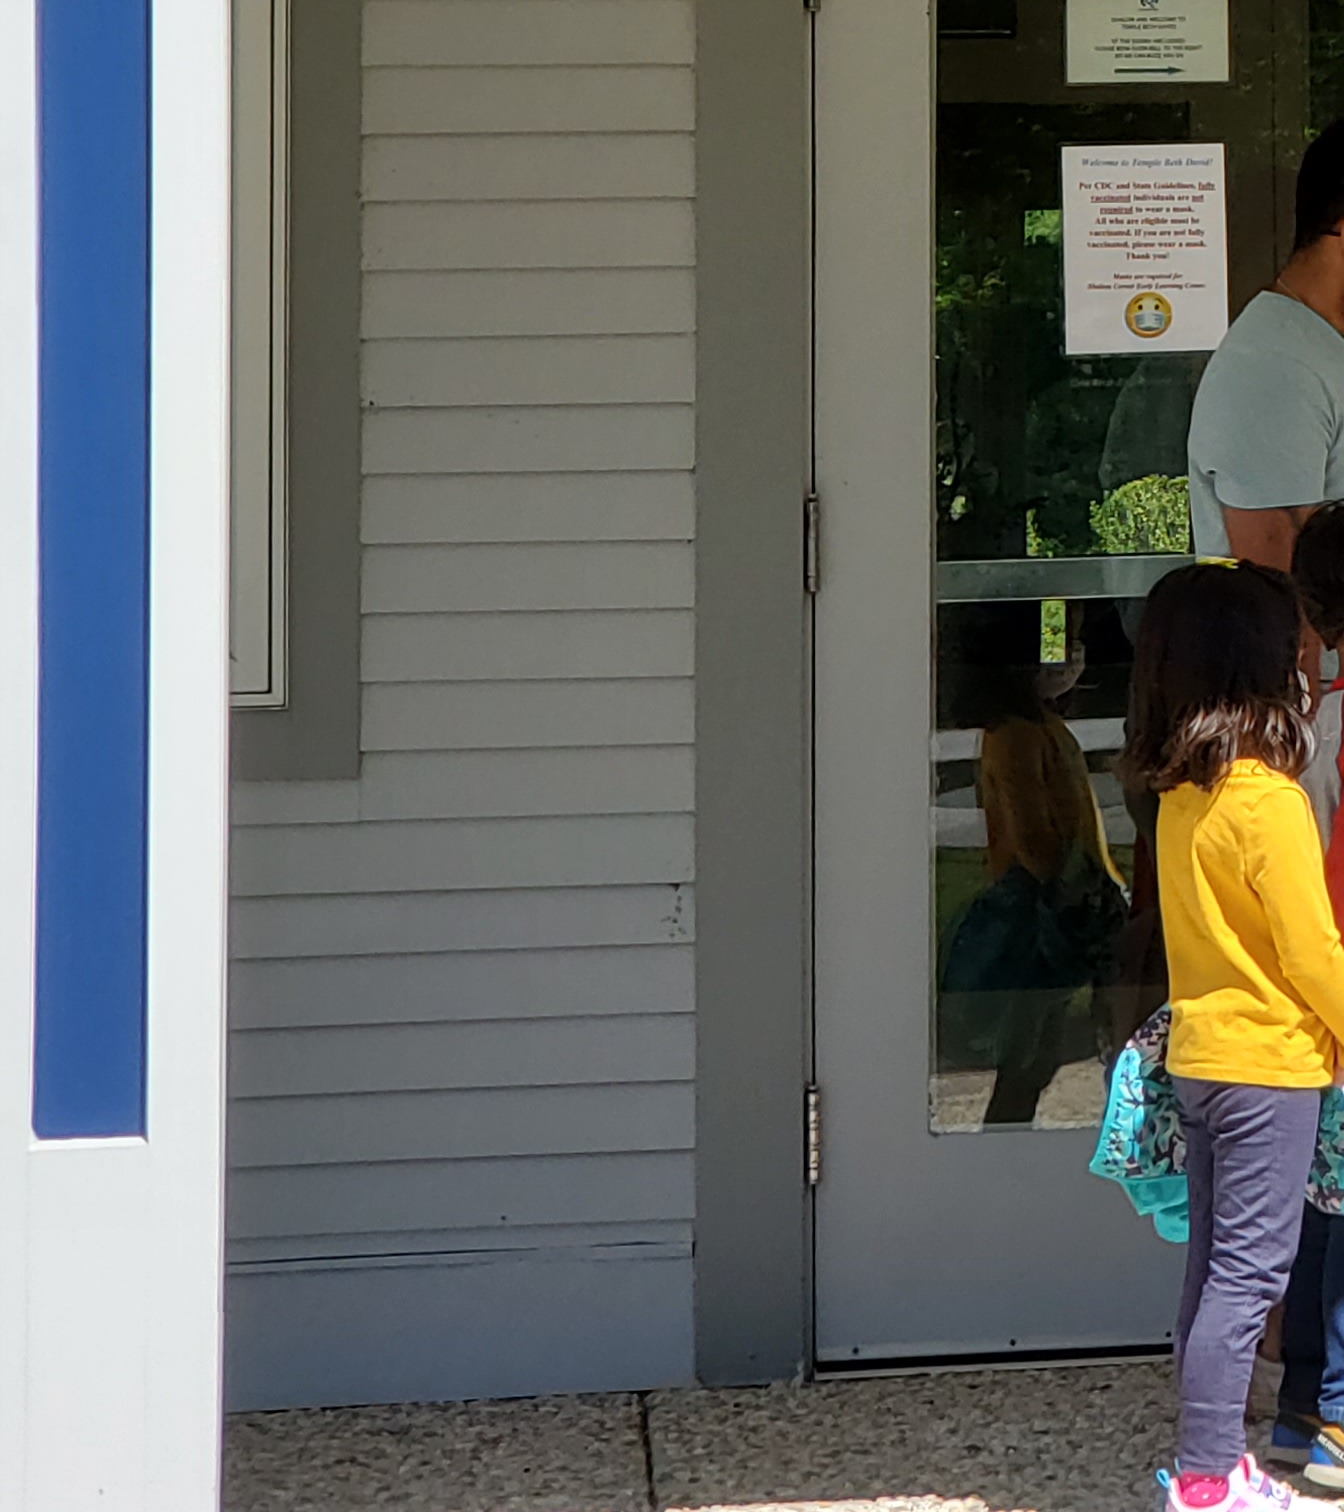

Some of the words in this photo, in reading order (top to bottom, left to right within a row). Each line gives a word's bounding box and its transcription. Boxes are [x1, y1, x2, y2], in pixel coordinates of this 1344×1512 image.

[1095, 182, 1114, 190] CDC
[1143, 230, 1157, 238] you
[1126, 252, 1151, 260] Thank
